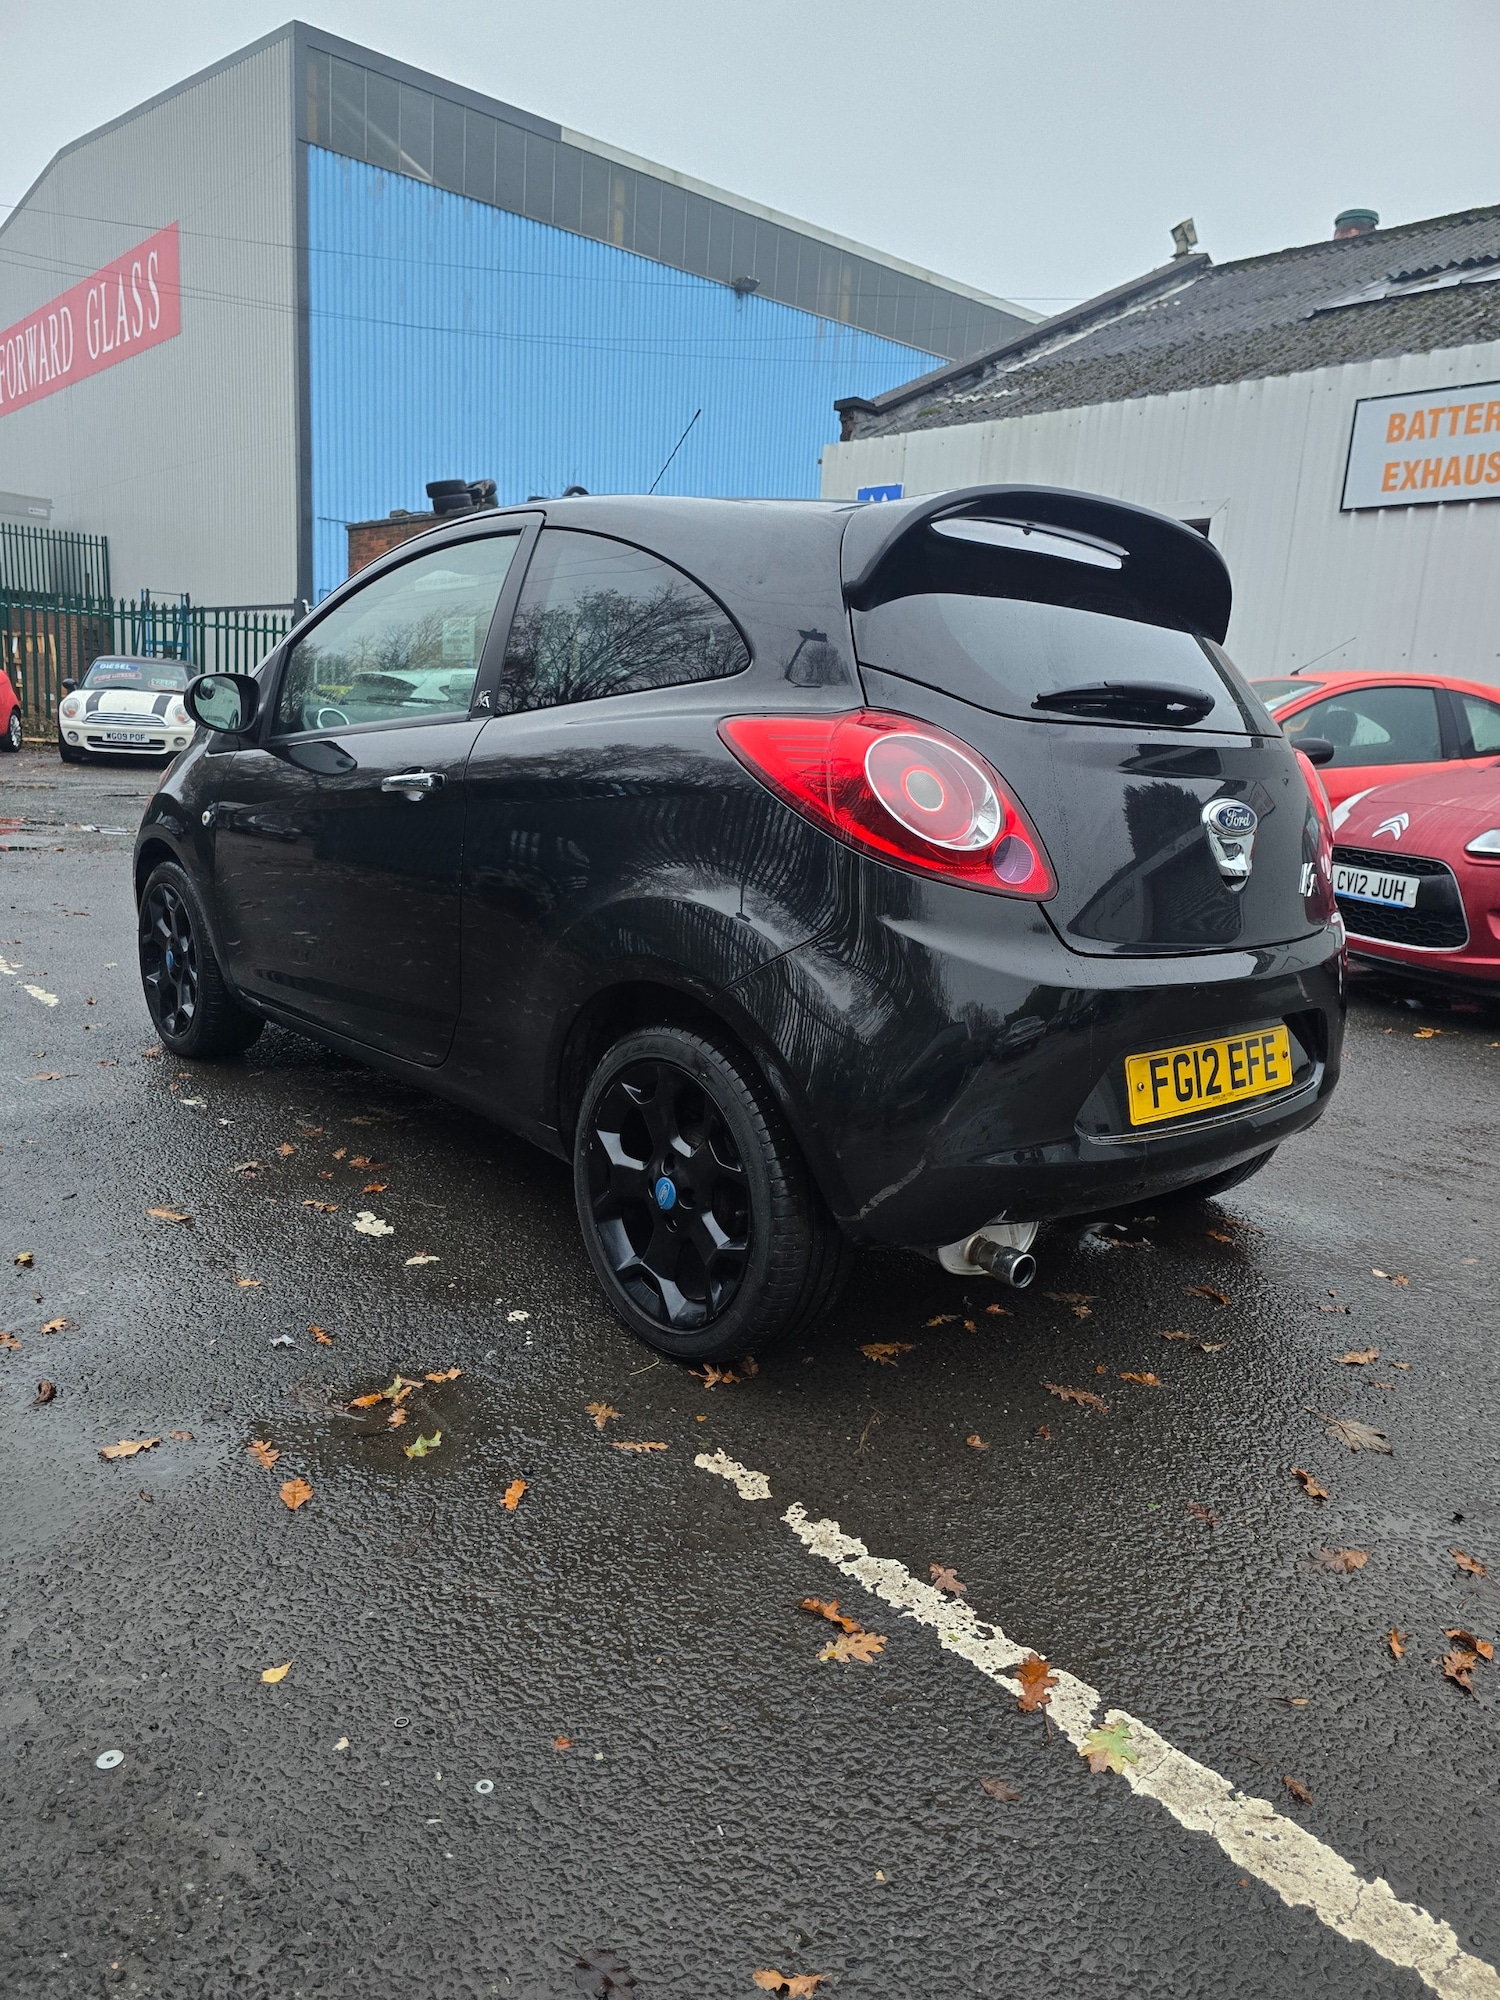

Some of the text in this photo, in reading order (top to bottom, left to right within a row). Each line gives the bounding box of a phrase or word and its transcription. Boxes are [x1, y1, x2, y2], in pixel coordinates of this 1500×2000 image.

[0, 249, 161, 405] FORWARD GLASS
[1386, 400, 1500, 444] BATTER
[1381, 451, 1500, 493] EXHAUS
[100, 663, 132, 671] DIESEL
[129, 733, 146, 742] POF
[1225, 807, 1251, 827] Ford
[1337, 870, 1407, 902] CV12 JUH
[1149, 1034, 1278, 1109] FG12 EFE
